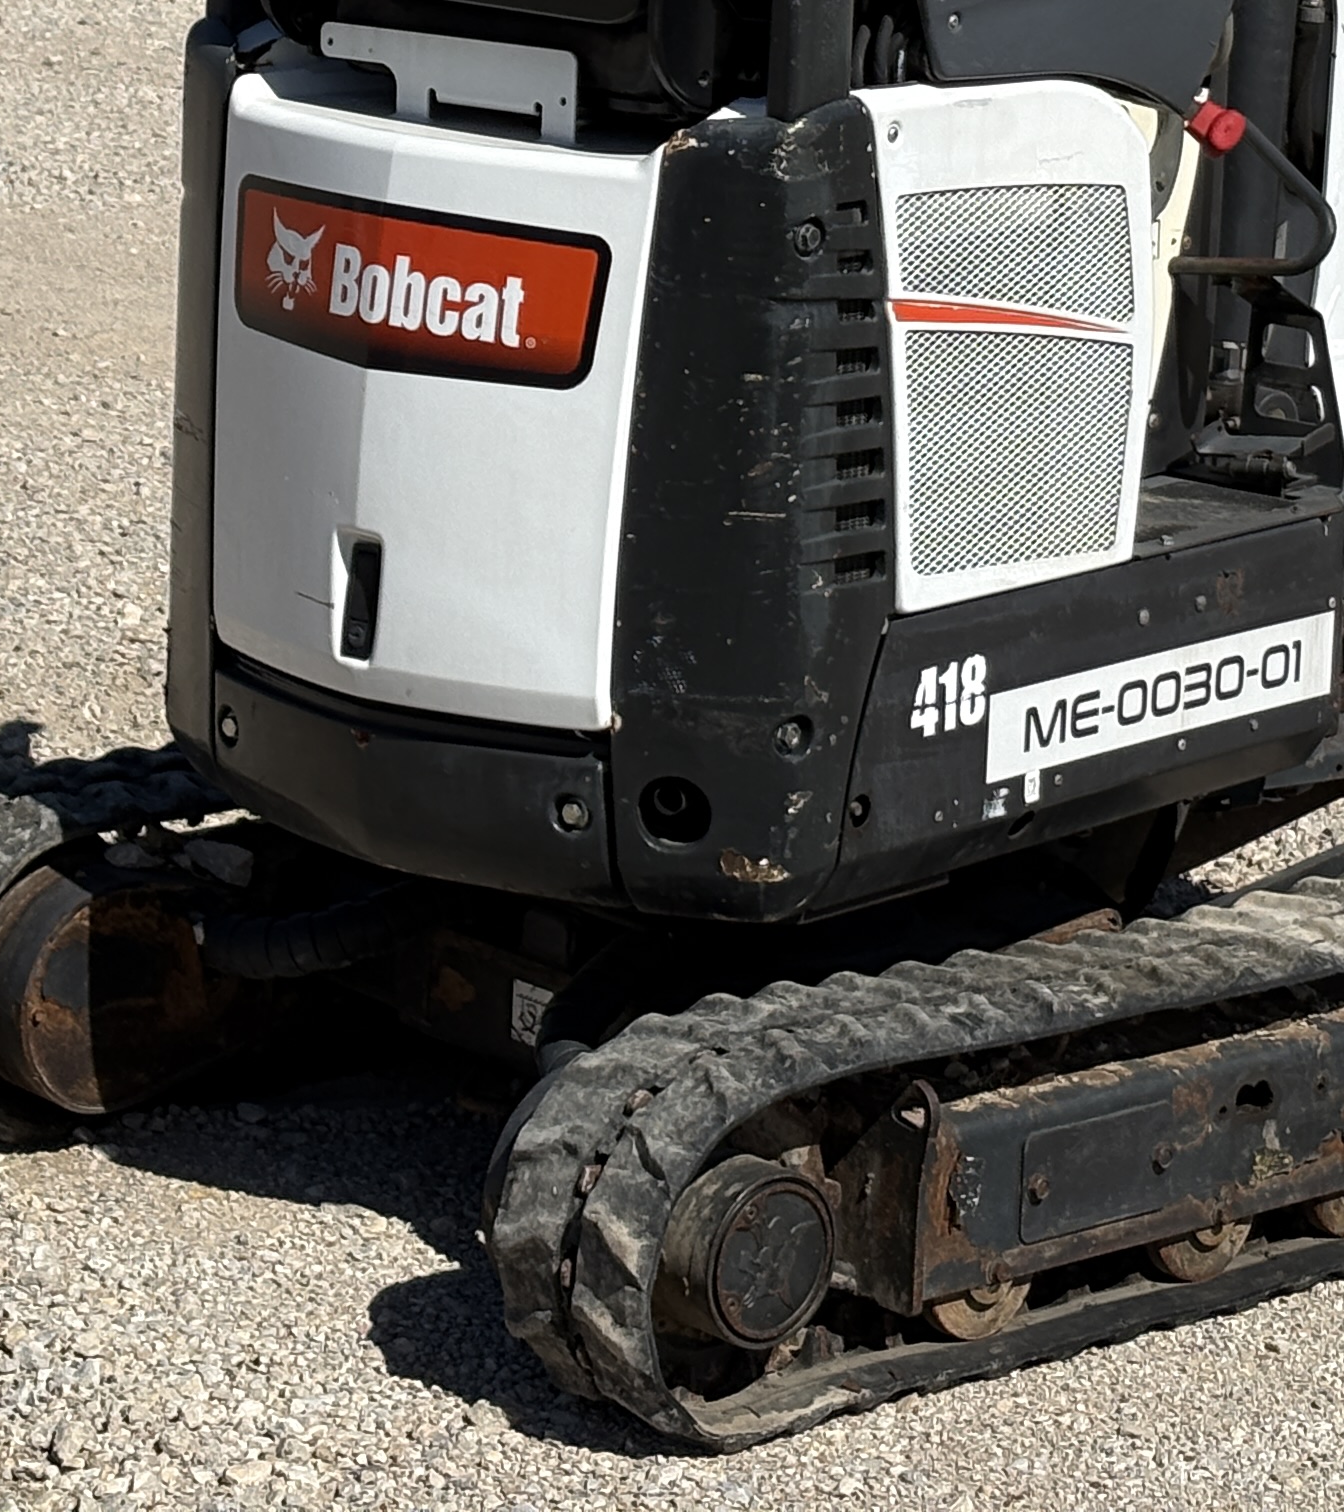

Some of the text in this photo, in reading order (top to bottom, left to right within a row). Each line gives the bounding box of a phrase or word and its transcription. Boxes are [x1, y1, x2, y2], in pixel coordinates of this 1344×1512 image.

[328, 242, 525, 349] Bobcat
[910, 653, 987, 738] 418
[1023, 639, 1303, 753] ME-0030-01
